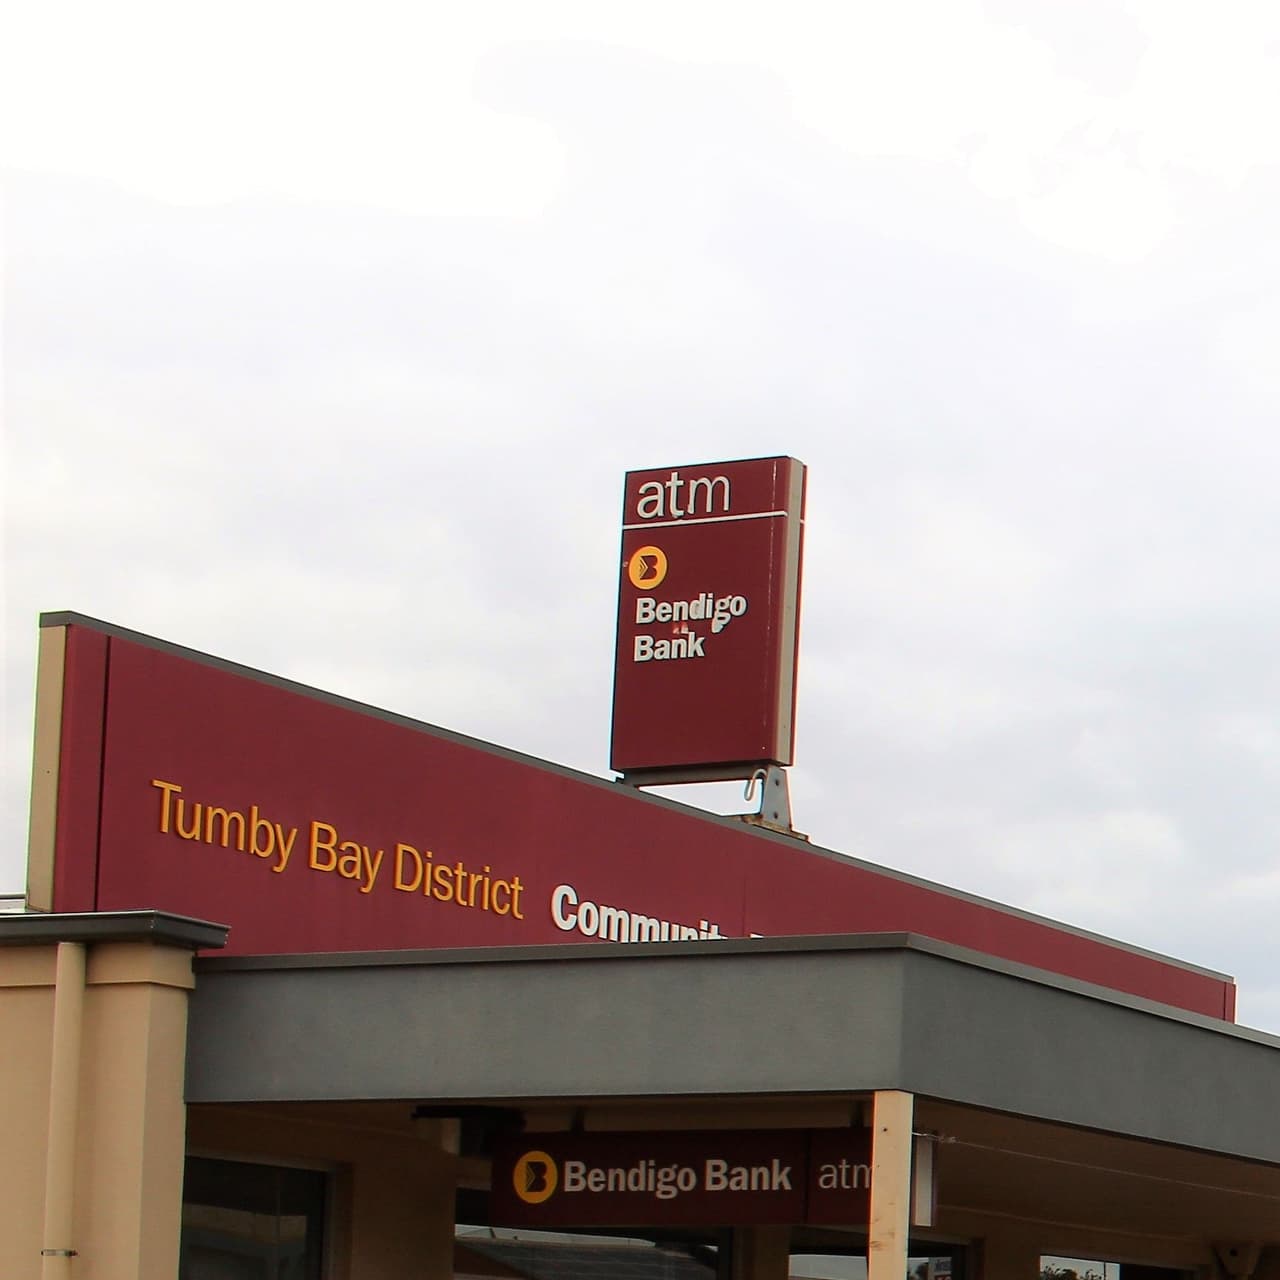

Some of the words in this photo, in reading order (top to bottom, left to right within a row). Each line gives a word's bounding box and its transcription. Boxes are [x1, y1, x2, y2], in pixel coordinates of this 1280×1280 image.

[637, 472, 730, 519] atm
[636, 593, 747, 633] Bendigo
[634, 631, 705, 662] Bank
[152, 779, 297, 873] Tumby
[309, 821, 384, 893] Bay
[394, 843, 524, 920] District
[551, 884, 728, 943] Commu
[564, 1159, 697, 1199] Bendigo
[705, 1158, 793, 1191] Bank
